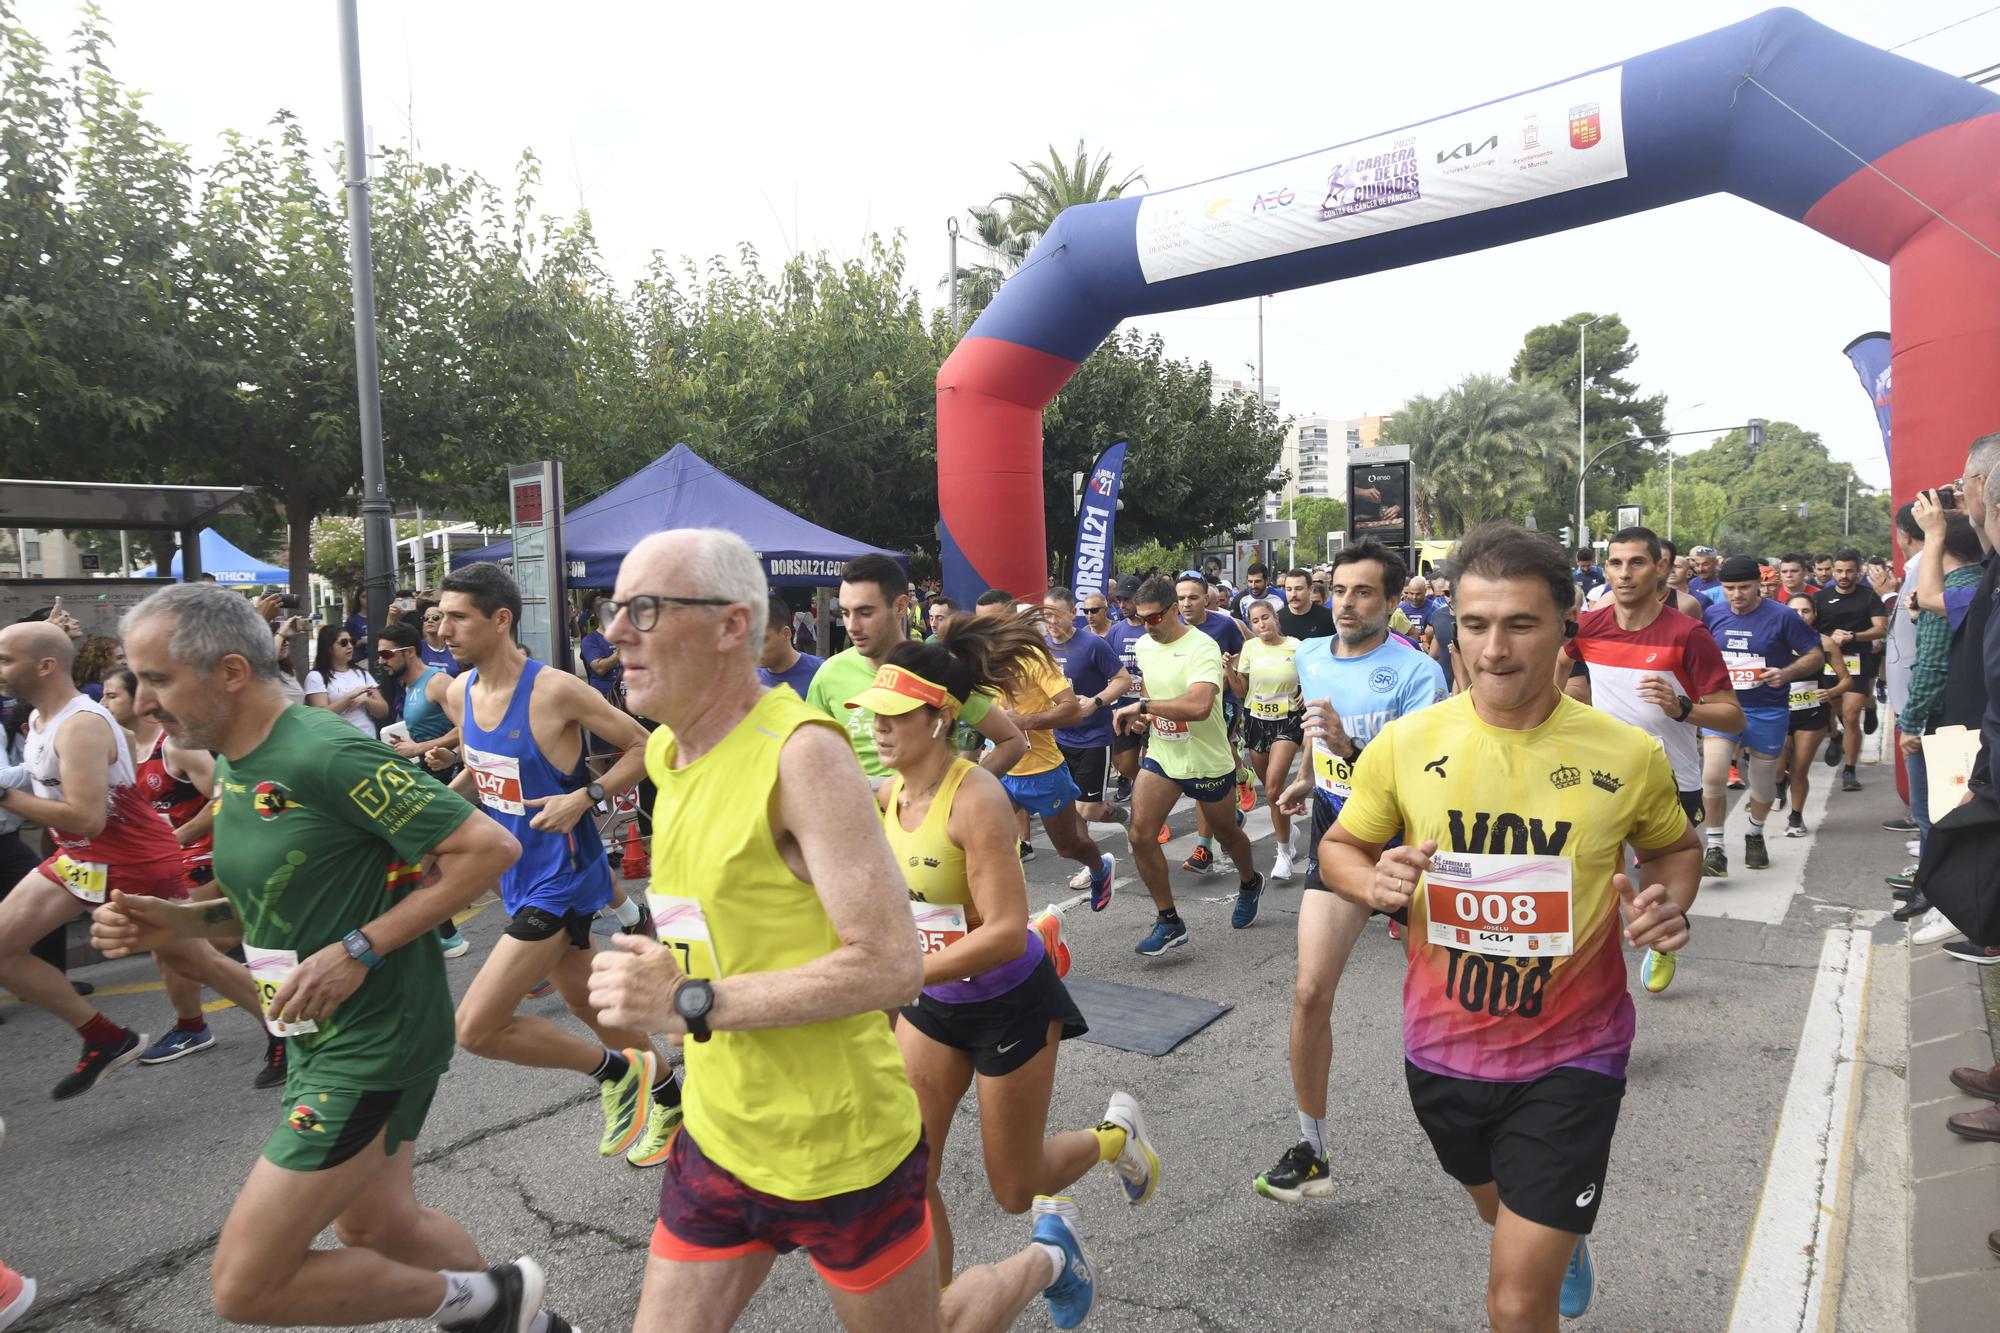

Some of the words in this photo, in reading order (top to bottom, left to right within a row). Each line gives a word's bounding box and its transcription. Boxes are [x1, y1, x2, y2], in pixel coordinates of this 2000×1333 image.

[1394, 137, 1416, 150] 2022
[1437, 135, 1498, 164] KIA
[1356, 147, 1415, 173] CARRERA
[1513, 150, 1553, 165] Ayuntamiento
[1527, 160, 1549, 170] Murcia
[1374, 165, 1391, 181] DE
[1394, 159, 1418, 179] LAS
[1353, 173, 1420, 202] CIUDADES
[1323, 207, 1346, 218] CONTRA
[1346, 204, 1355, 213] EL
[1099, 477, 1112, 496] 21
[1375, 674, 1391, 684] SR
[1257, 703, 1279, 713] 358
[1156, 717, 1177, 731] 089
[1326, 759, 1354, 780] 16
[475, 771, 505, 795] 047
[379, 784, 428, 826] TERRAZAS
[1448, 810, 1572, 856] VOY
[1455, 892, 1538, 926] 008
[1480, 933, 1513, 942] KIA
